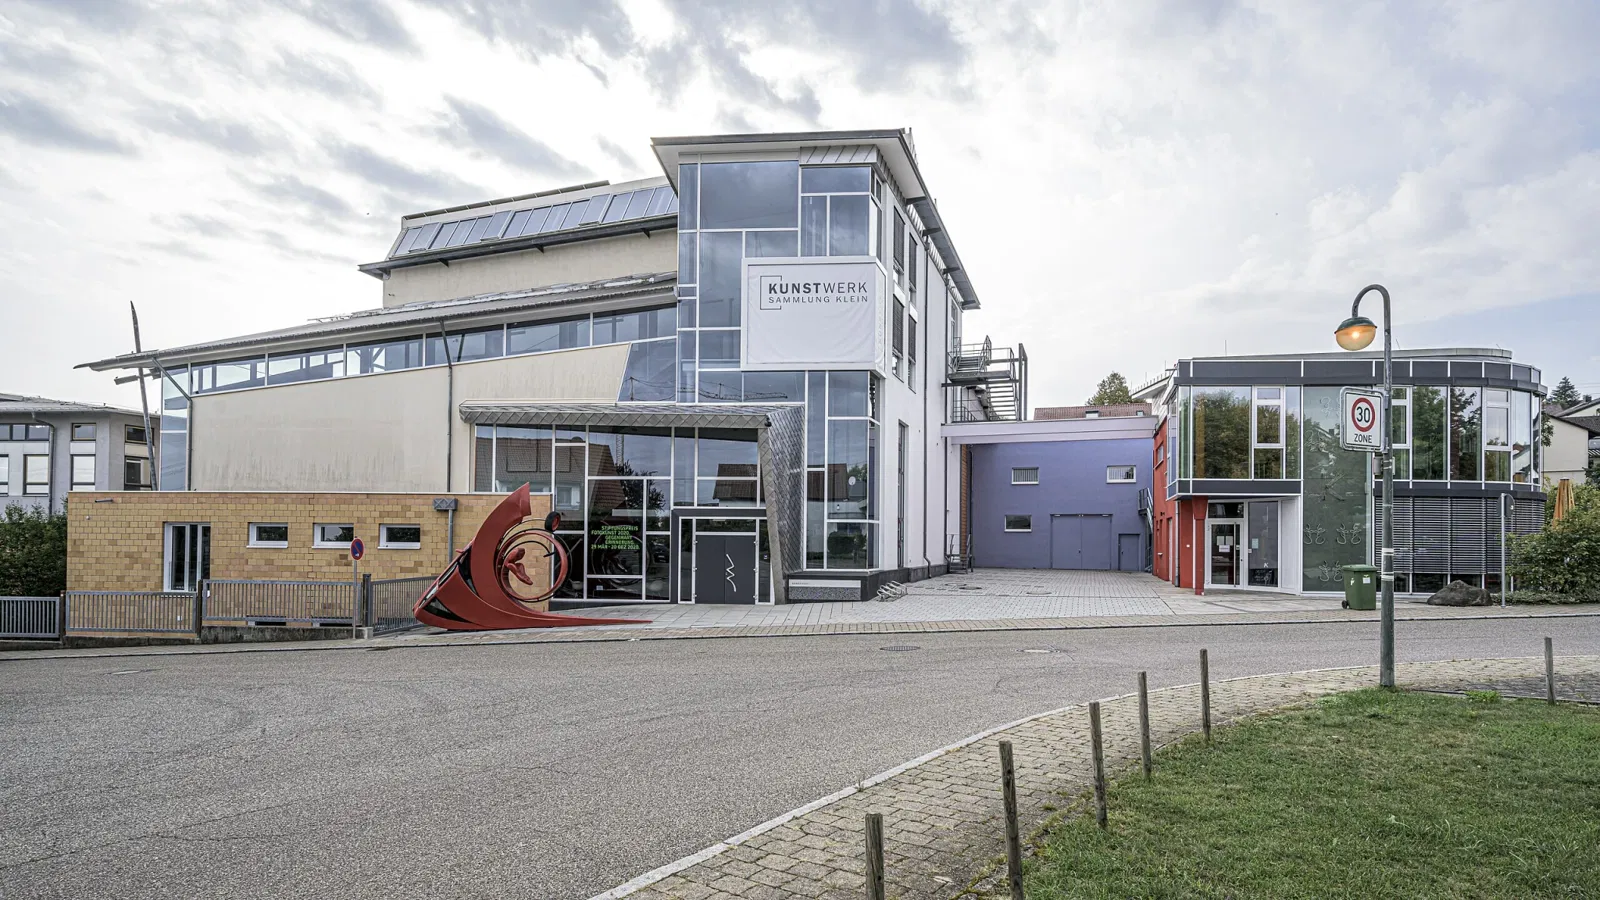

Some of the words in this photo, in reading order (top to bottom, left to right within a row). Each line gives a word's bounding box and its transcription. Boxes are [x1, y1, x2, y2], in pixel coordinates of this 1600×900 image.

[768, 282, 868, 294] KUNSTWERK
[768, 296, 831, 304] SAMMLUNG
[835, 295, 868, 303] KLEIN
[1356, 406, 1370, 423] 30
[1354, 433, 1372, 443] ZONE
